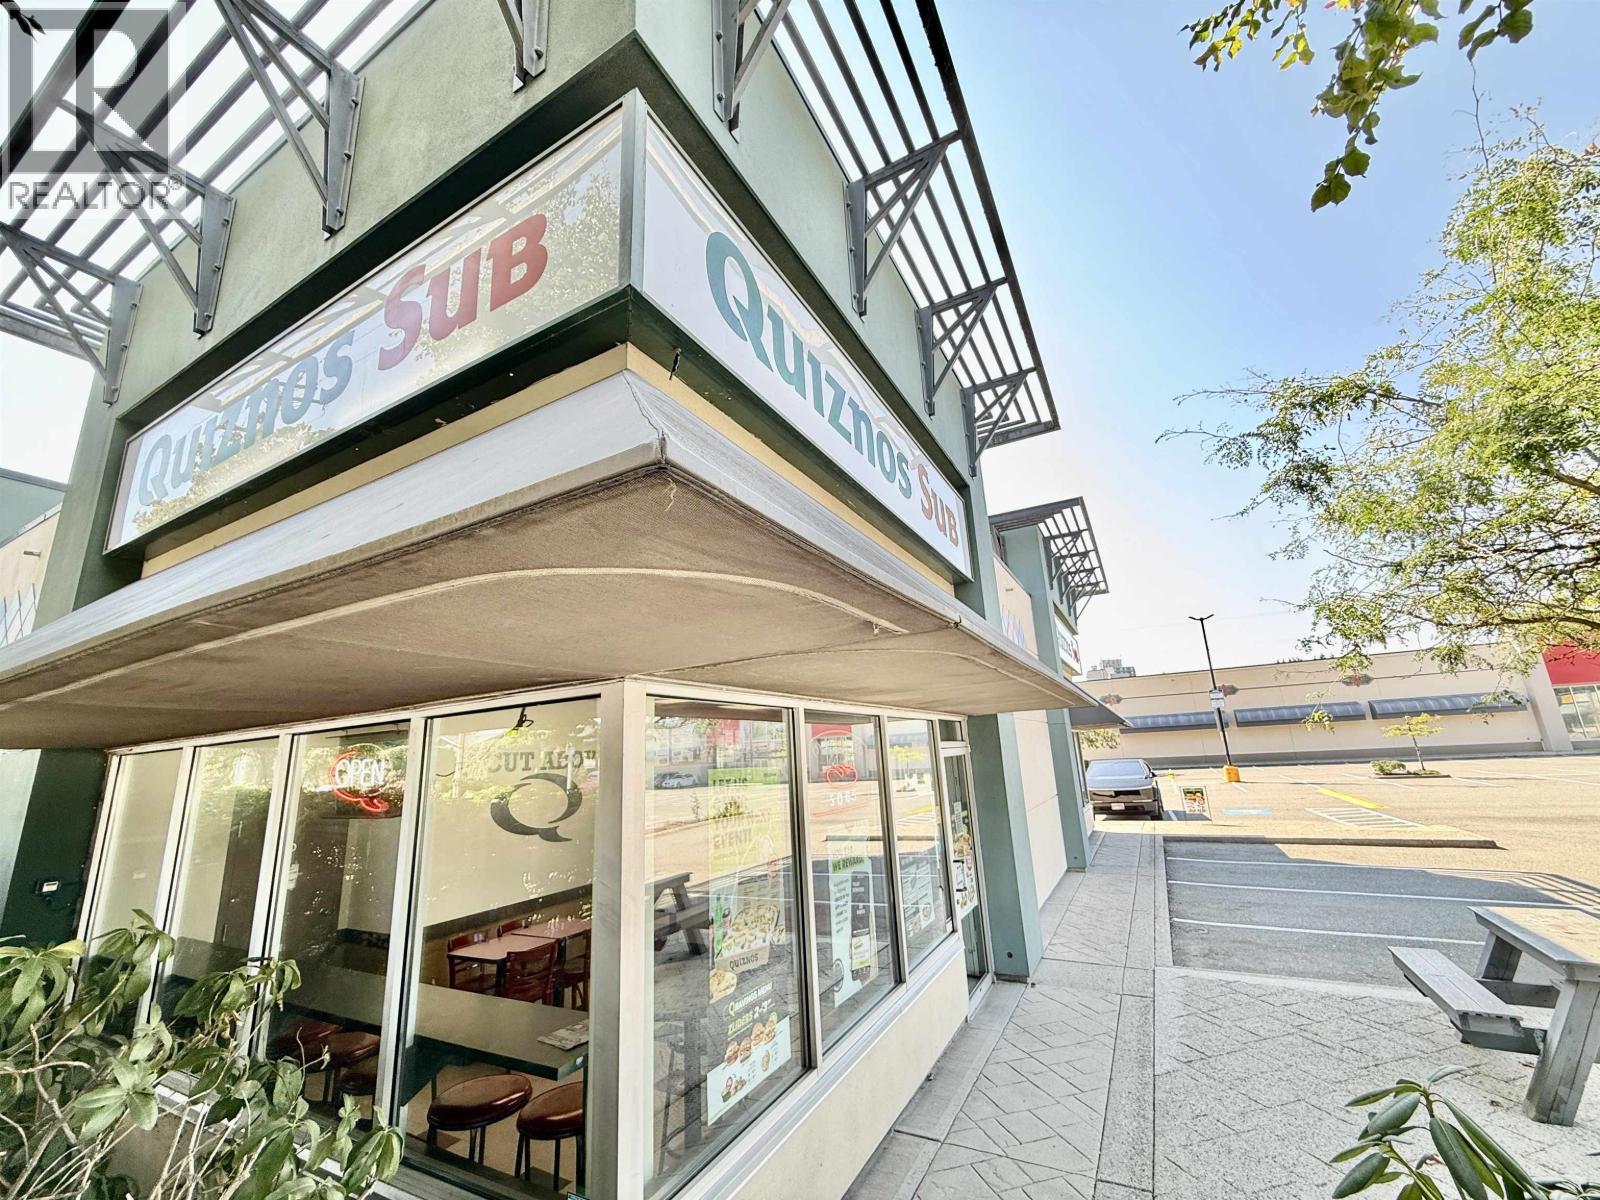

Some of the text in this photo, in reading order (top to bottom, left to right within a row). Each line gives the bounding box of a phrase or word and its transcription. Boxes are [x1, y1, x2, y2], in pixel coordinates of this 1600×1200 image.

[335, 758, 385, 788] OPEN
[487, 751, 535, 774] CUT
[729, 953, 759, 971] QUIZNOS
